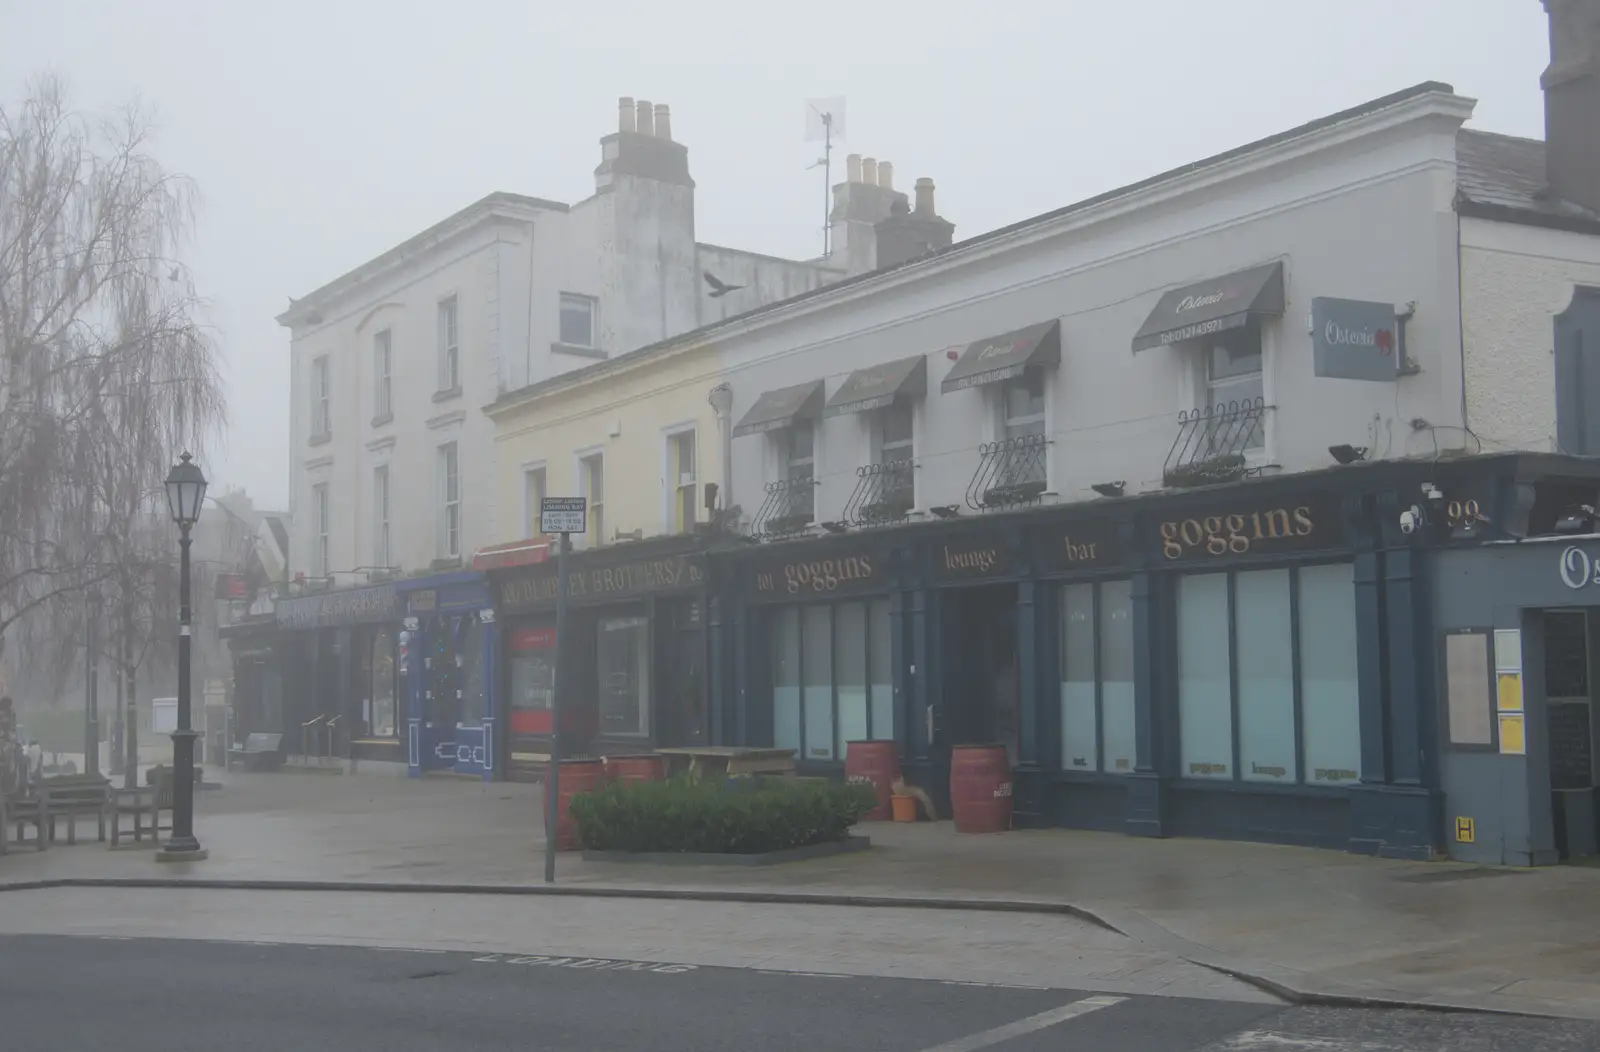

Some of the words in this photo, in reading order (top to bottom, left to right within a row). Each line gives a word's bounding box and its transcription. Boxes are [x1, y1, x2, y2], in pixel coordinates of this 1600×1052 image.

[1176, 289, 1224, 314] Osteria
[1325, 319, 1375, 346] Osteria
[1447, 499, 1479, 528] 99
[1160, 506, 1315, 560] goggins
[944, 545, 997, 572] lounge
[1064, 536, 1097, 562] bar
[784, 555, 872, 594] goggins
[472, 953, 699, 974] LOADING
